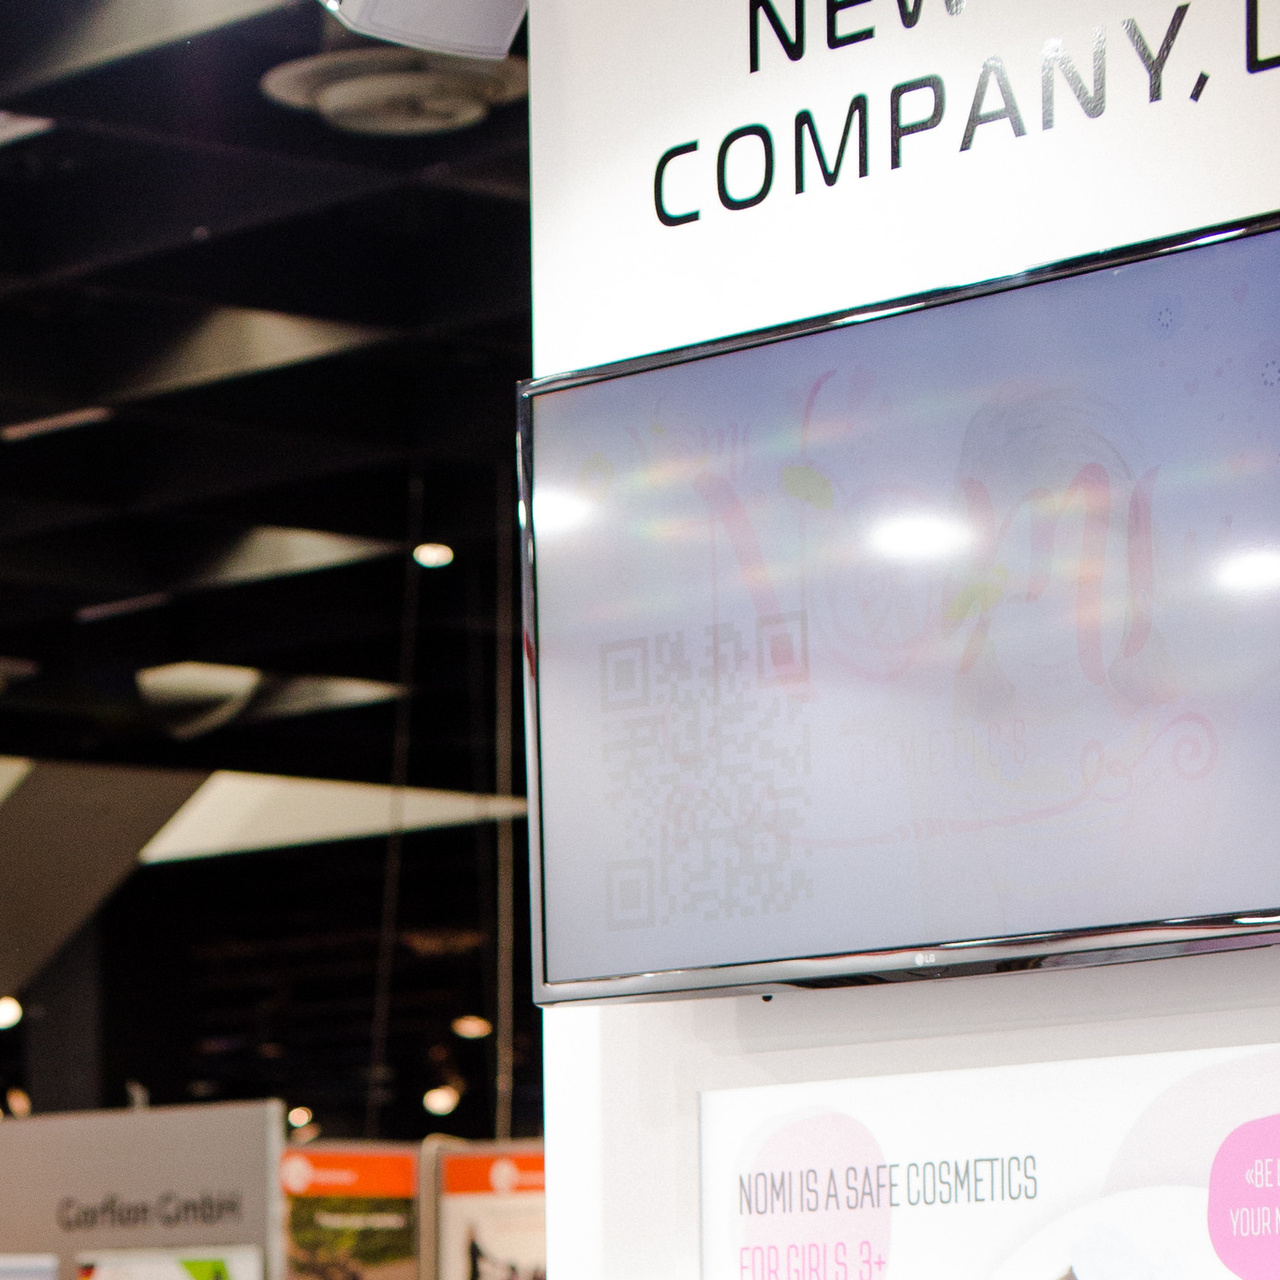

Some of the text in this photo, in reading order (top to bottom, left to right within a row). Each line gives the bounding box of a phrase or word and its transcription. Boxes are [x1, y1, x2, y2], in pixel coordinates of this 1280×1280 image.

[653, 4, 1210, 228] COMPANY,
[738, 1156, 1038, 1215] NOMI IS A SAFE COSMETICS
[1229, 1206, 1272, 1237] YOUR
